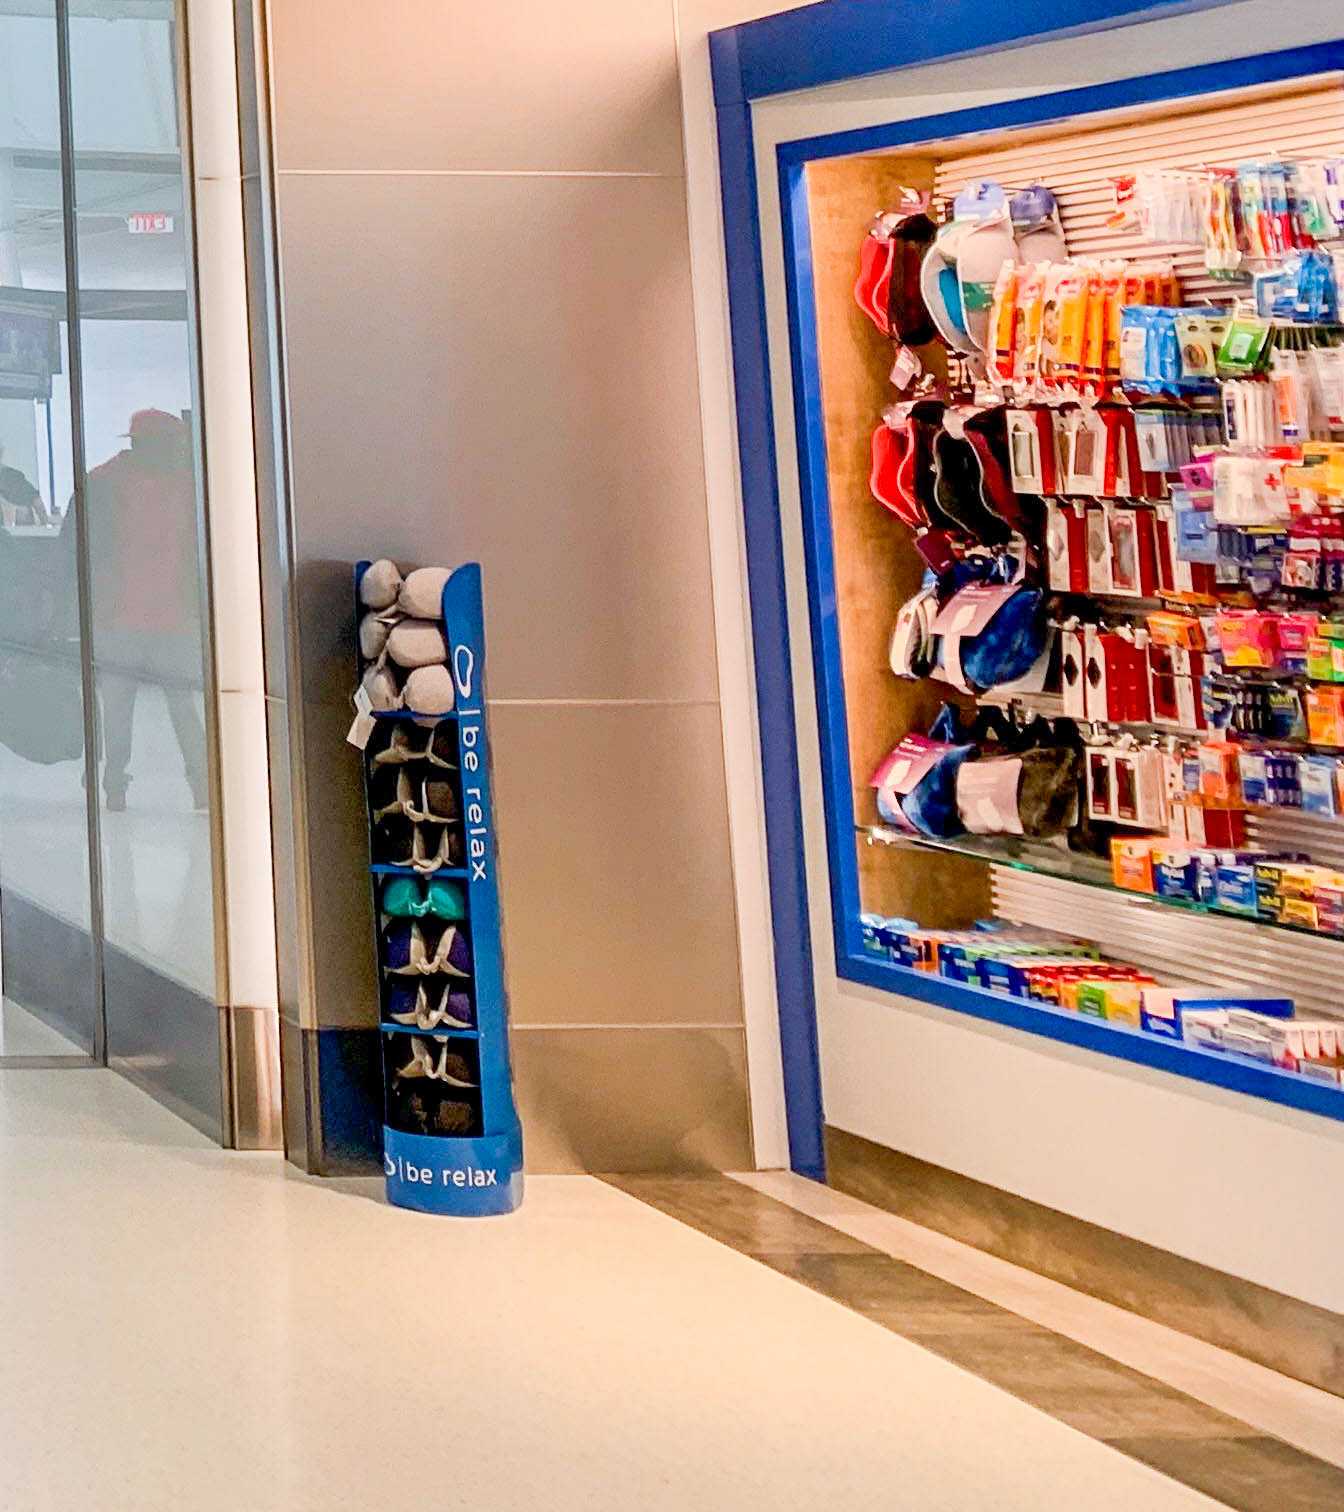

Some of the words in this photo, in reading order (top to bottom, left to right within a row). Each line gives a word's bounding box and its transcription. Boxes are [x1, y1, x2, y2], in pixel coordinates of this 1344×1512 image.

[459, 726, 479, 772] be
[466, 787, 486, 882] relax
[406, 1162, 433, 1185] be
[442, 1165, 498, 1187] relax
